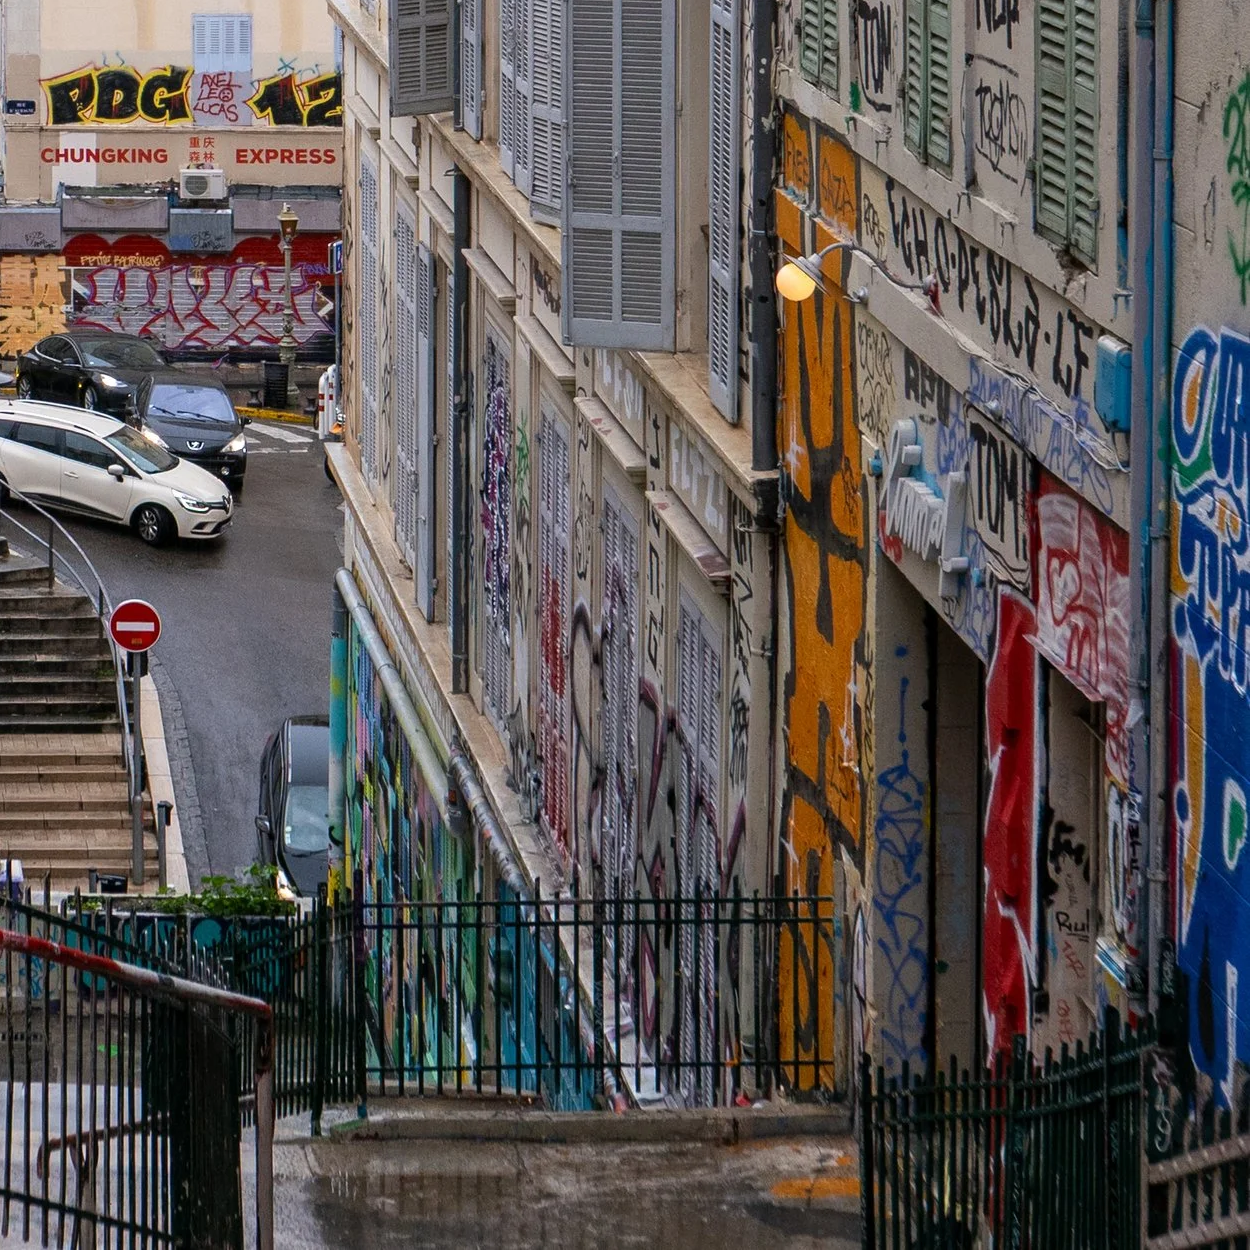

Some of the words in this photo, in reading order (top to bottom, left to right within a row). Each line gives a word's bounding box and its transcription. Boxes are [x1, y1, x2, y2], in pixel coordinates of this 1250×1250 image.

[200, 72, 243, 90] AXEL
[193, 101, 239, 122] LUCAS
[189, 137, 215, 149] 重庆
[40, 148, 168, 164] CHUNGKING
[189, 150, 215, 162] 森林
[236, 148, 336, 164] EXPRESS
